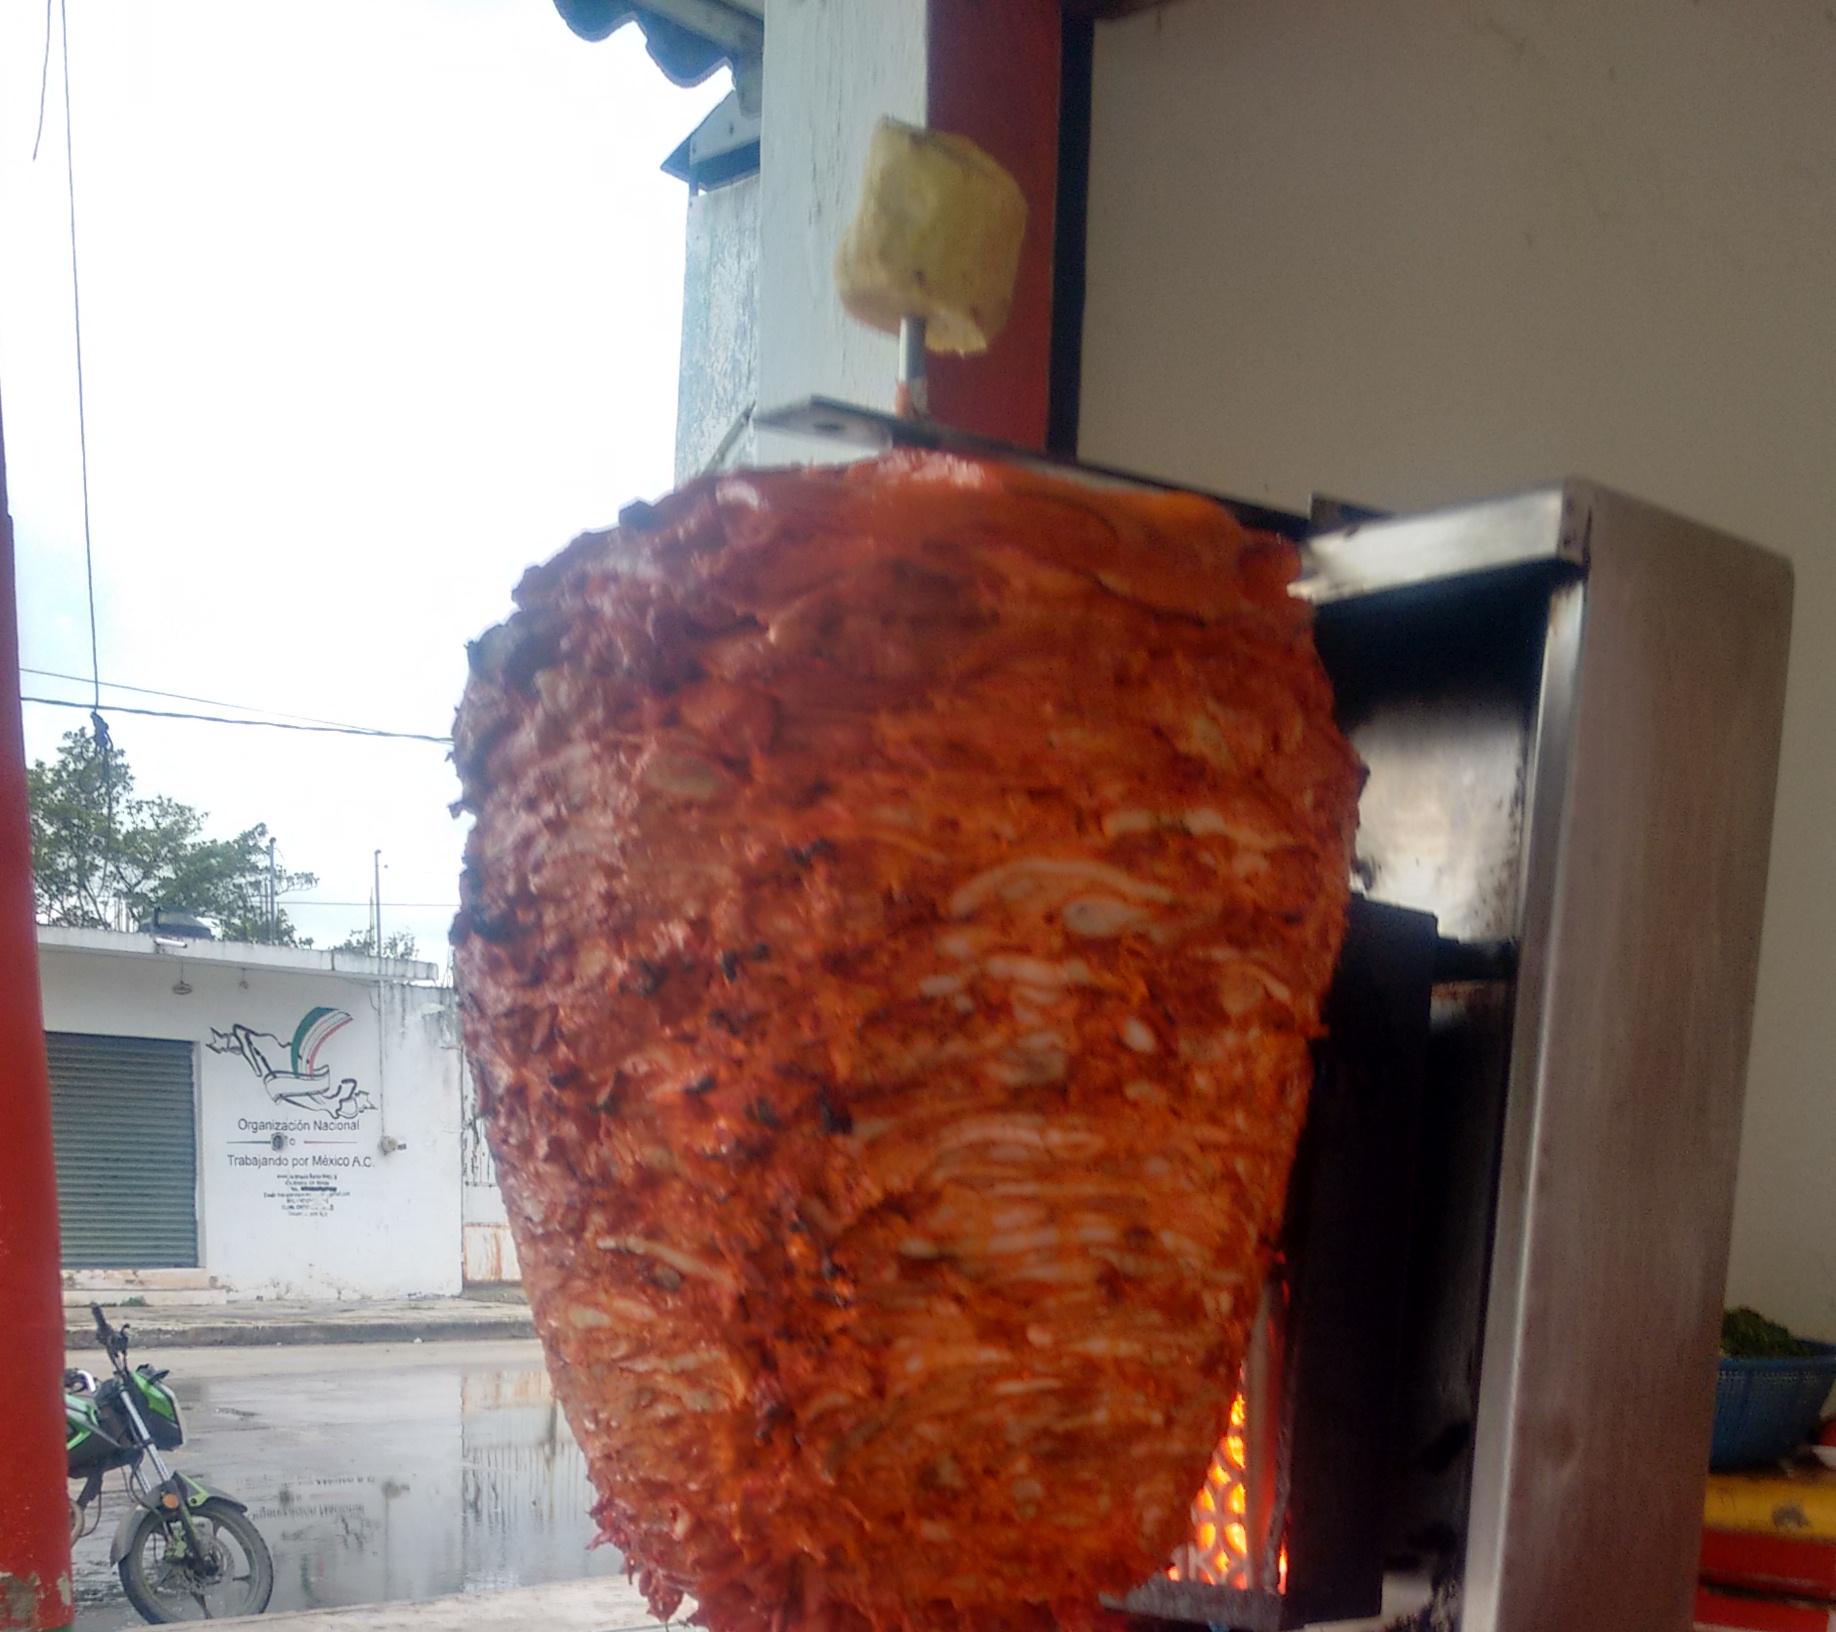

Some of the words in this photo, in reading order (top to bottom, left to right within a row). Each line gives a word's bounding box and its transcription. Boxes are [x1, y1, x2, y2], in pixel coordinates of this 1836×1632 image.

[238, 1118, 311, 1134] Organización
[313, 1119, 360, 1131] Nacional
[227, 1154, 289, 1169] Trabajando
[292, 1157, 310, 1168] por
[312, 1154, 350, 1168] México
[352, 1157, 375, 1168] A.C.
